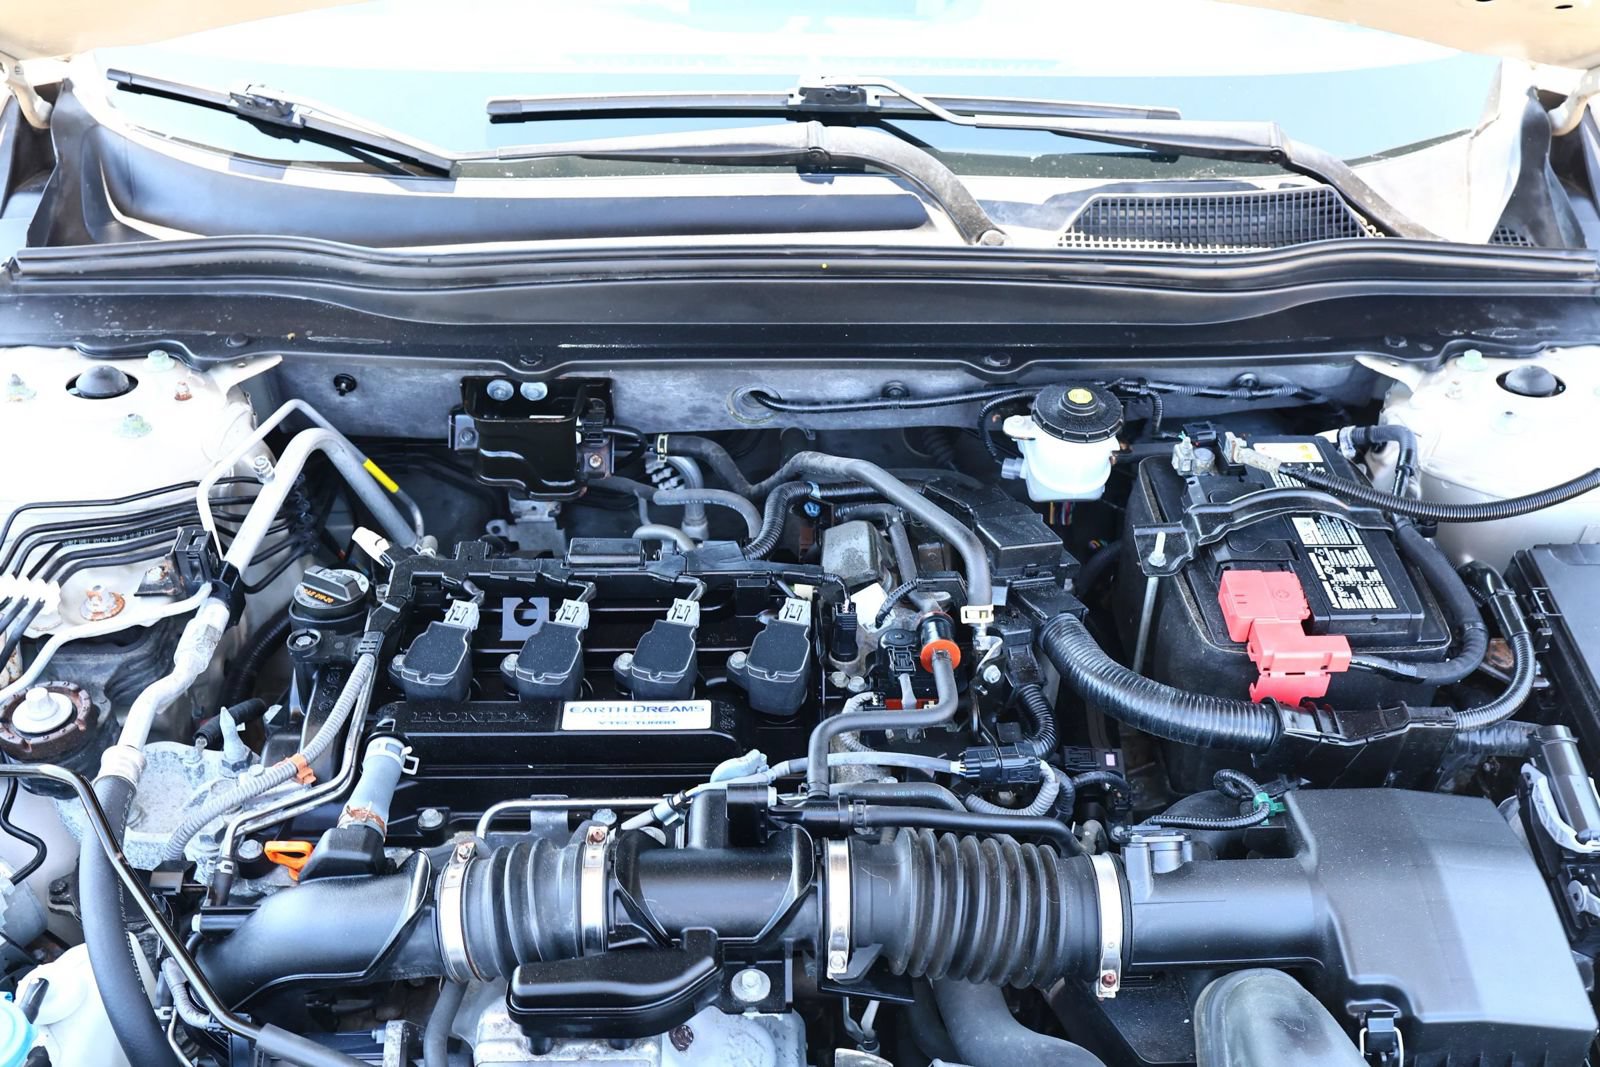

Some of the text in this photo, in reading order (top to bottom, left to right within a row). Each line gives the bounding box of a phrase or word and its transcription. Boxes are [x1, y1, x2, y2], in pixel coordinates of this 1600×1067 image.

[569, 704, 704, 713] EARTH DREAMS
[411, 711, 538, 723] HONDA
